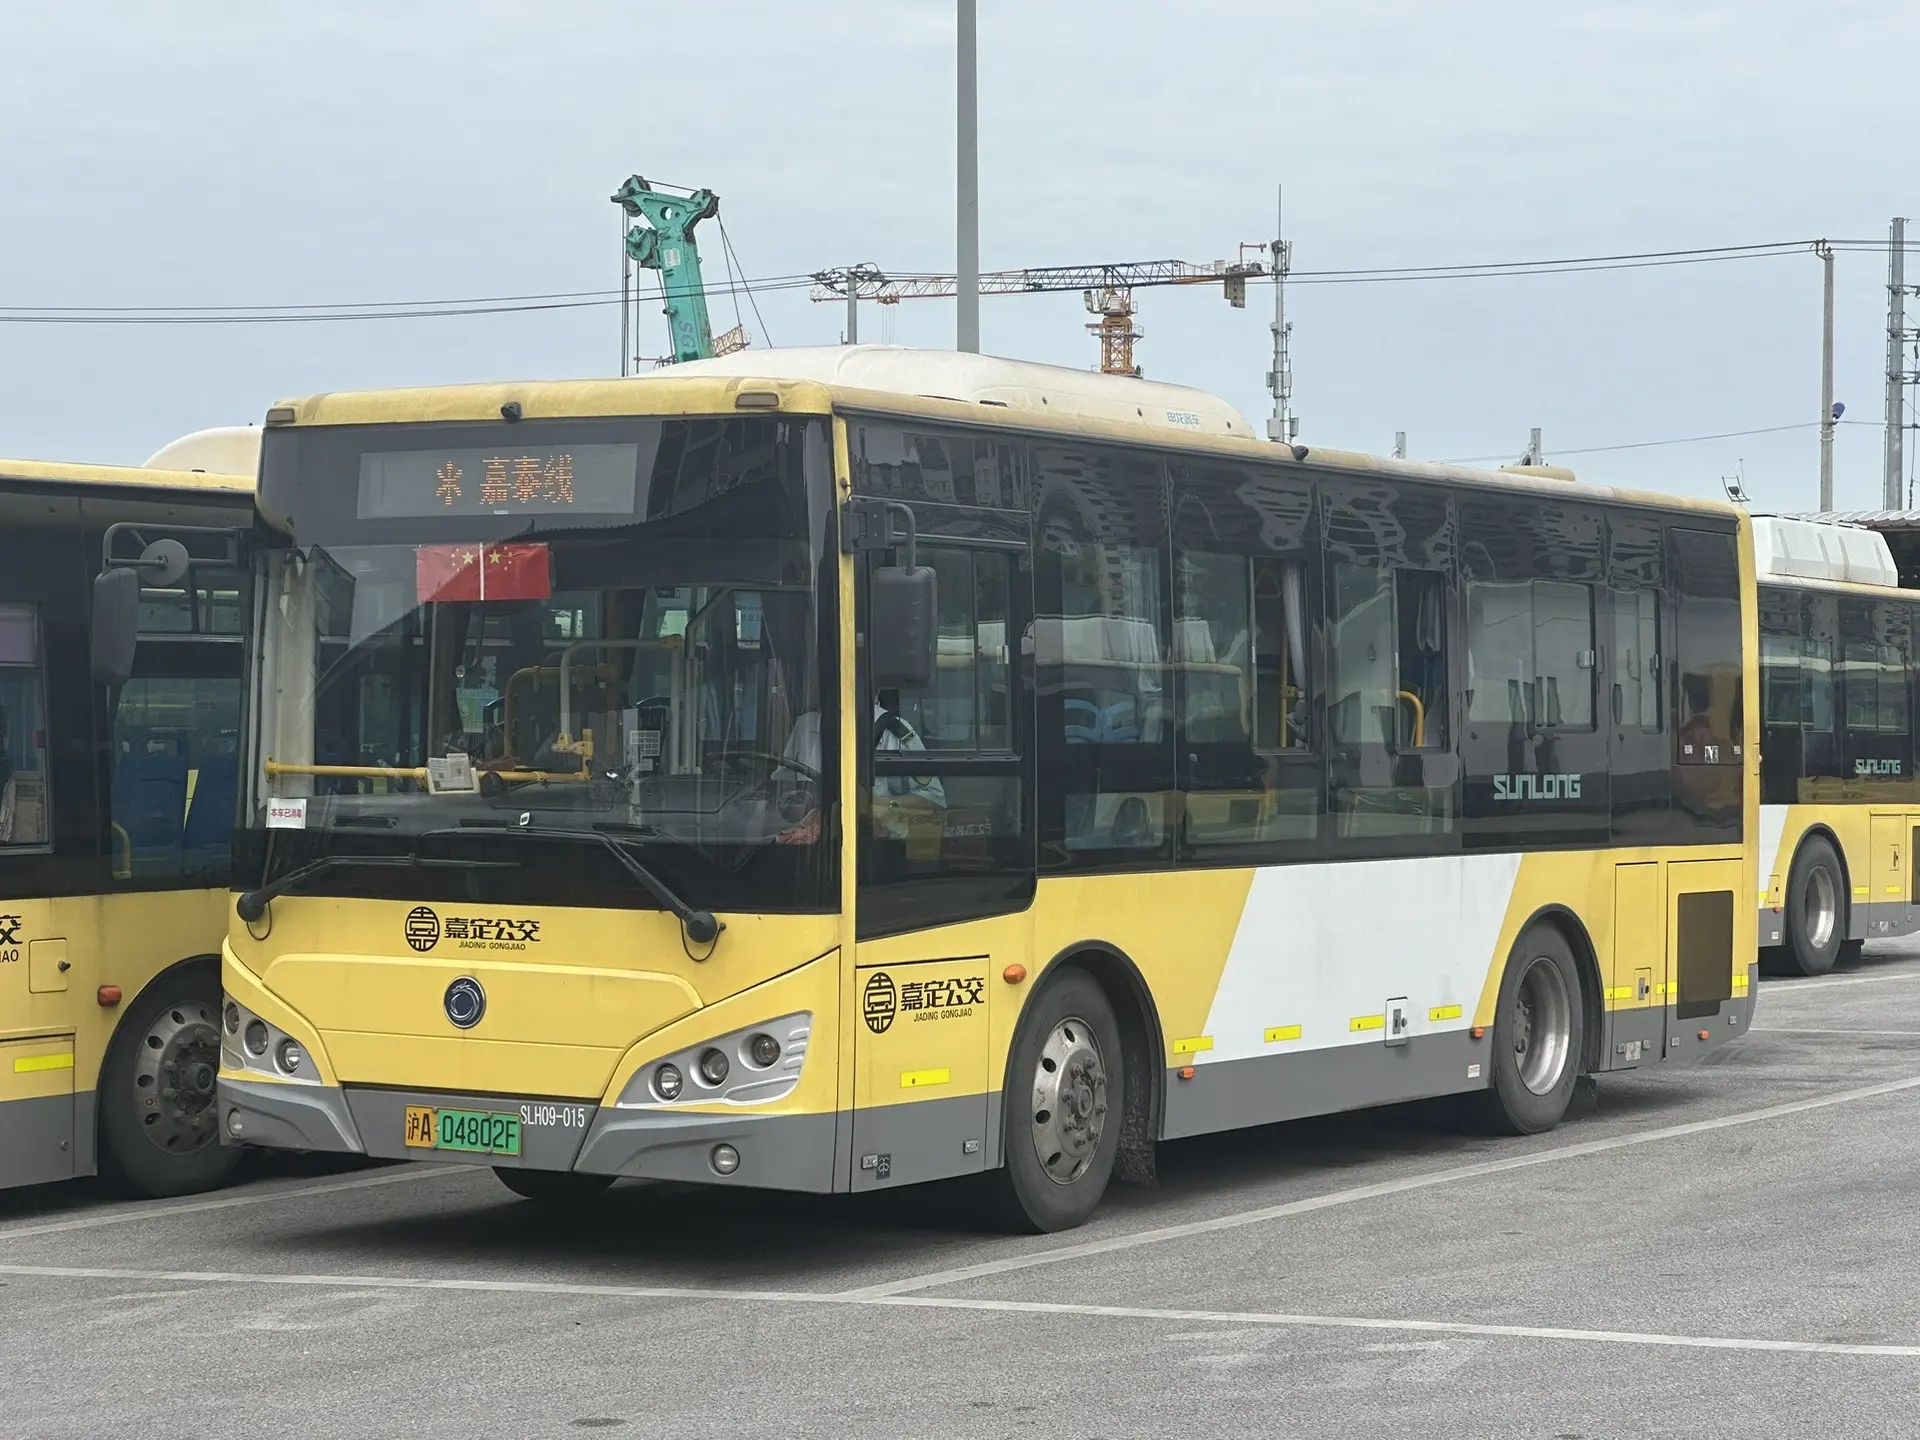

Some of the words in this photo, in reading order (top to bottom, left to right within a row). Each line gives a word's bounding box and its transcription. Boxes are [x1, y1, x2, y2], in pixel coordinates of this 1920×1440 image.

[1855, 758, 1901, 774] SUNLONG
[1493, 774, 1581, 800] SUNLONG
[444, 917, 541, 942] 嘉定公交
[458, 941, 486, 950] JIADING
[489, 942, 526, 951] GONGJIAO
[900, 977, 985, 1012] 嘉定公交
[913, 1011, 939, 1022] JIADING
[940, 1007, 973, 1020] GONGJIAO
[520, 1105, 585, 1128] SLH09-015
[407, 1112, 432, 1142] 沪A
[442, 1115, 517, 1149] 04802F
